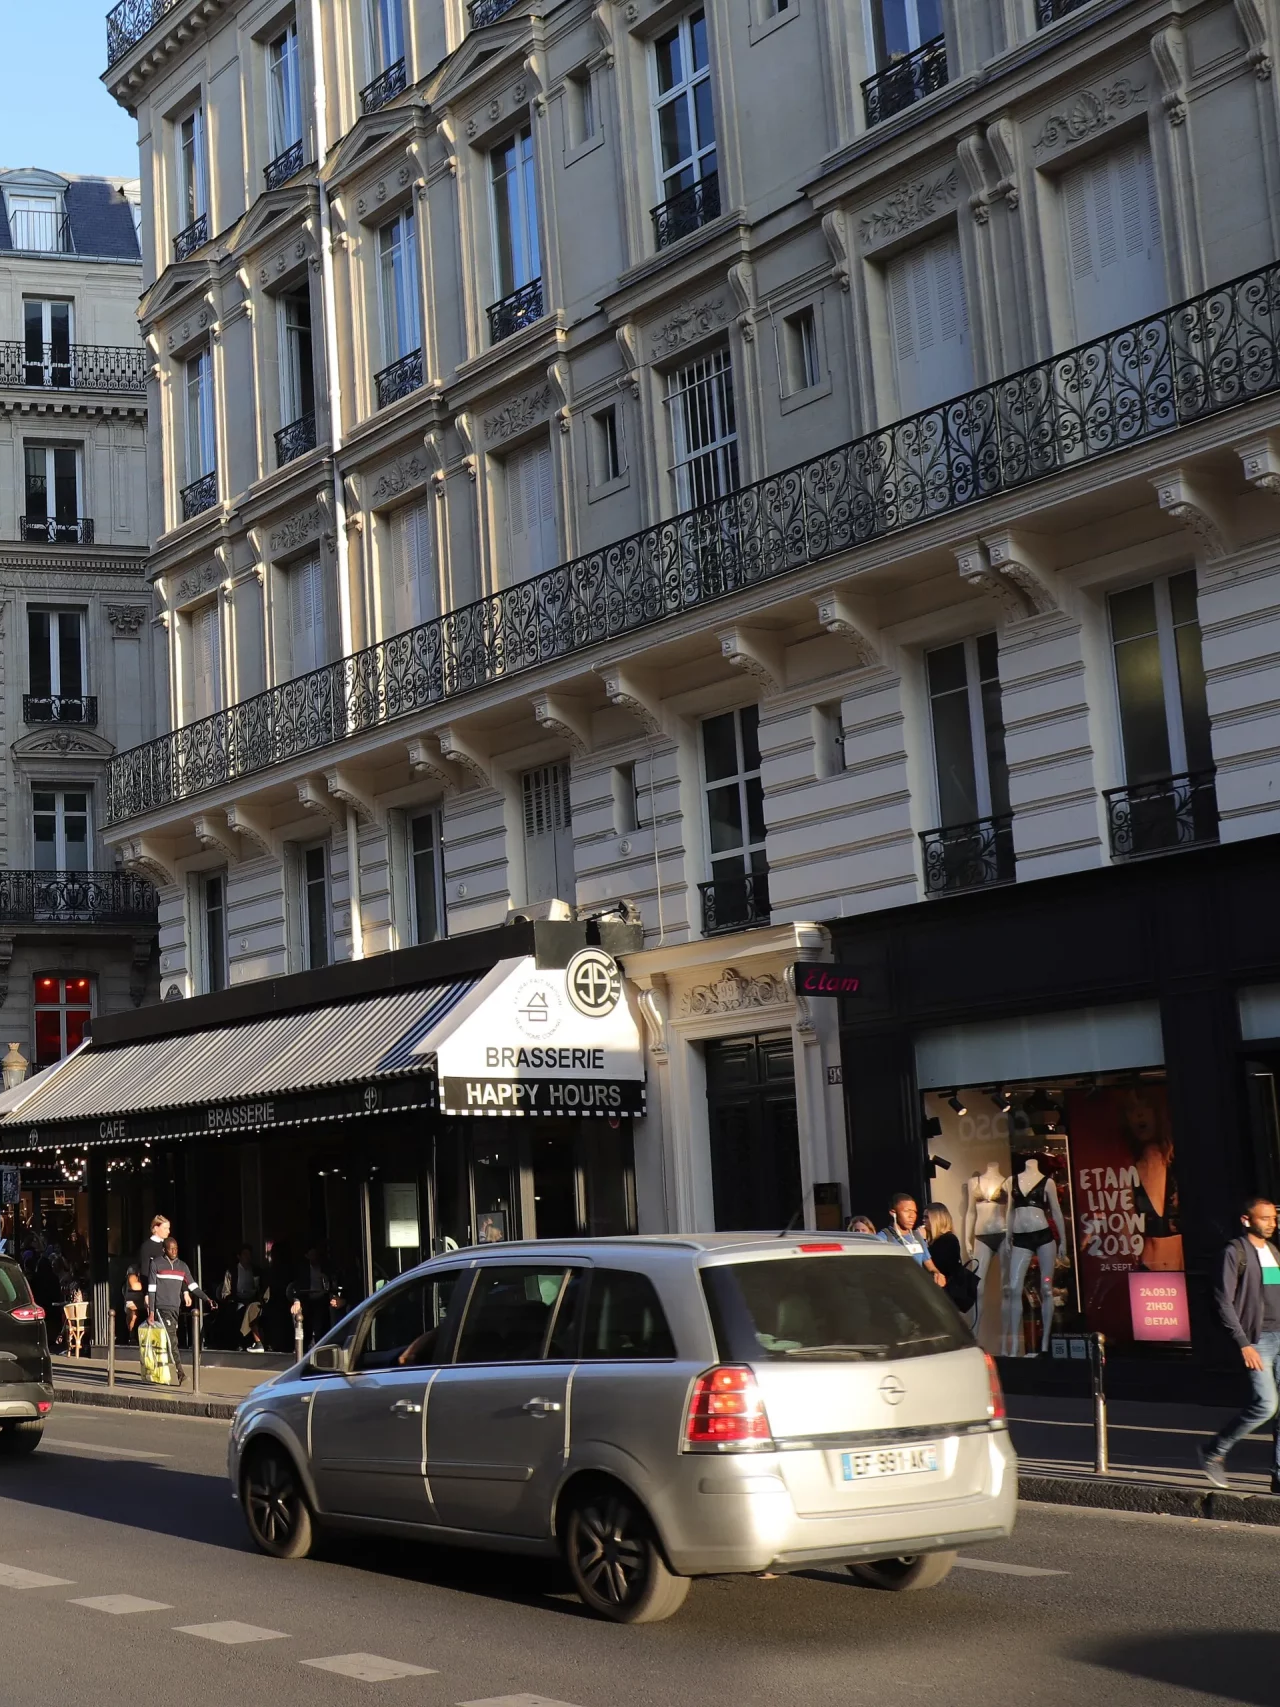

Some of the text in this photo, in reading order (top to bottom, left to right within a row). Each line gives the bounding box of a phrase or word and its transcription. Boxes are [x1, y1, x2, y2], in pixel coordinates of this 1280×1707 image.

[804, 968, 860, 991] Etam
[486, 1047, 605, 1069] BRASSERIE
[466, 1082, 621, 1107] HAPPY HOURS
[99, 1102, 275, 1139] CAFE BRASSERIE
[1079, 1166, 1140, 1190] ETAM
[1088, 1189, 1134, 1211] LIVE
[1081, 1212, 1146, 1235] SHOW
[1088, 1234, 1145, 1256] 2019
[1100, 1263, 1134, 1271] 24 SEPT.
[1140, 1288, 1177, 1297] 24.09.19
[1146, 1302, 1174, 1311] 21H30
